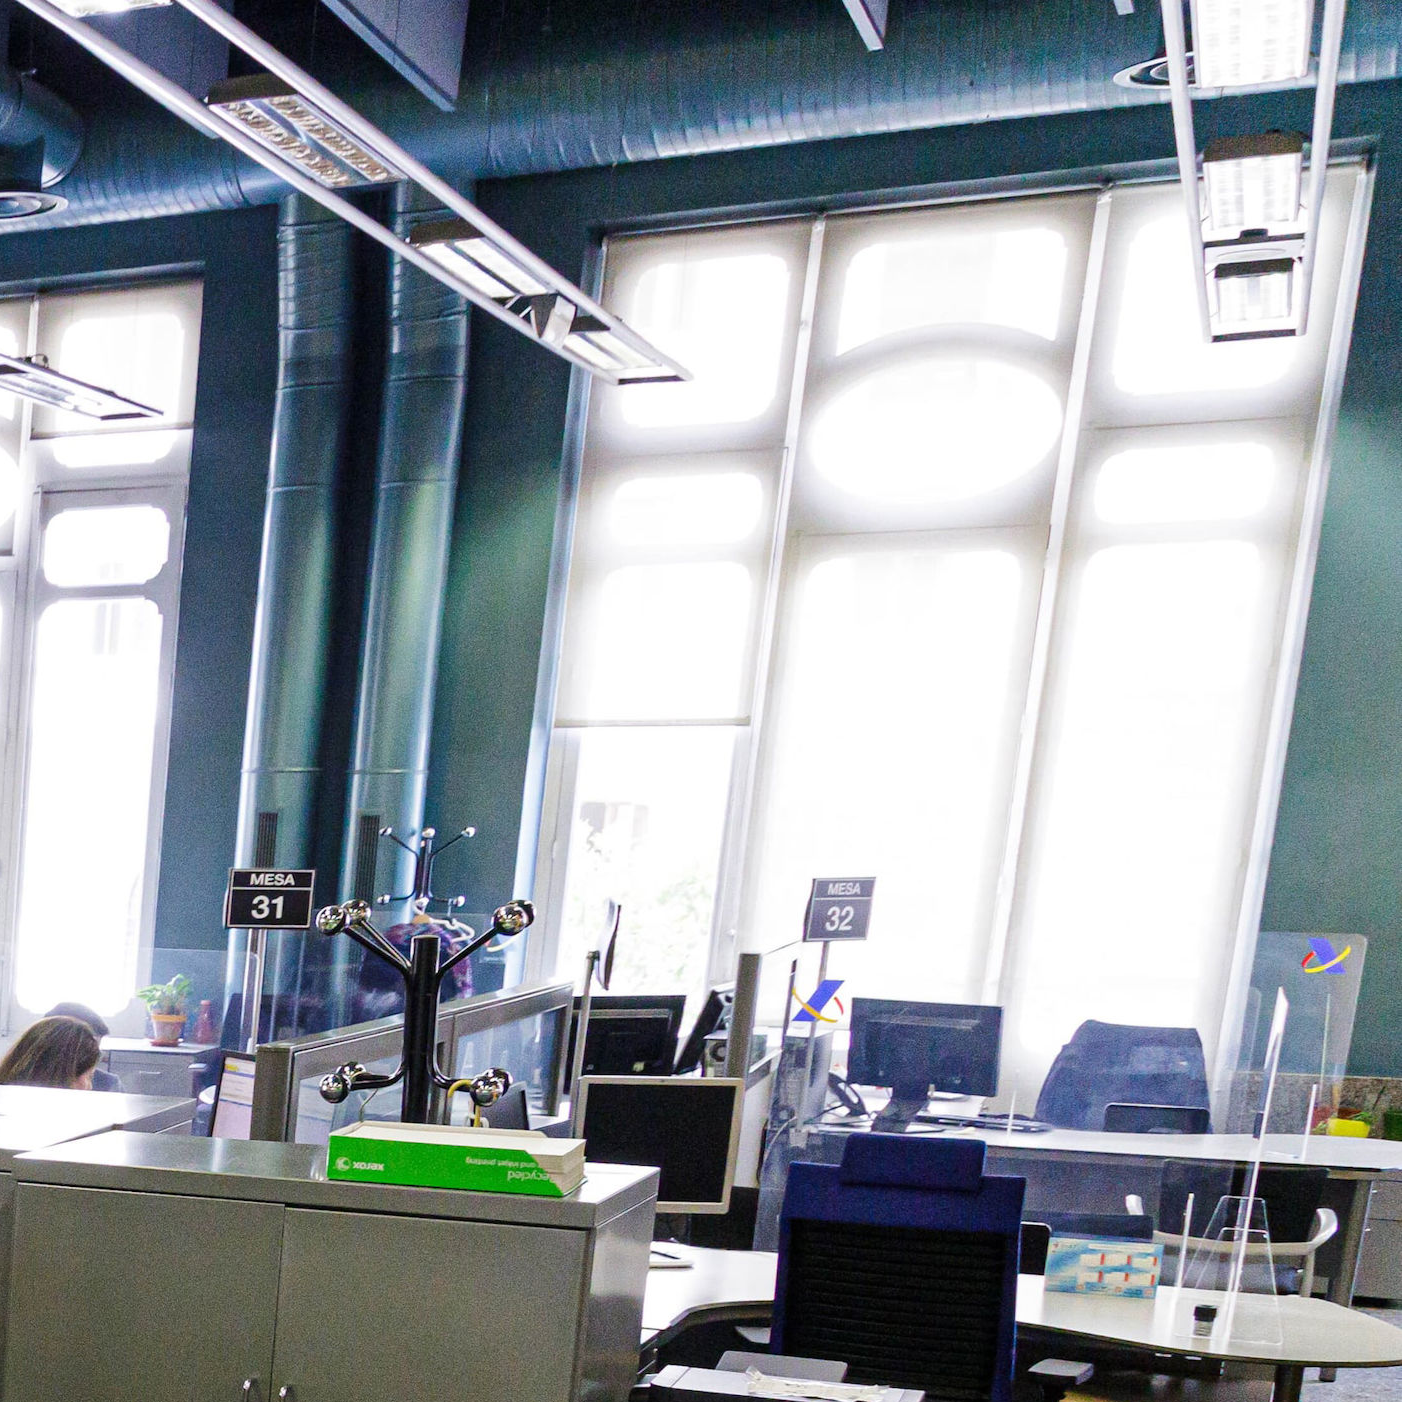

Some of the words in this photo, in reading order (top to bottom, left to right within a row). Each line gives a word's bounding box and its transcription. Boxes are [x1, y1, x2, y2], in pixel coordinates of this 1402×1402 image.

[249, 874, 295, 886] MESA
[827, 882, 861, 896] MESA
[251, 895, 285, 919] 31
[825, 906, 854, 931] 32
[352, 1161, 385, 1171] xerox
